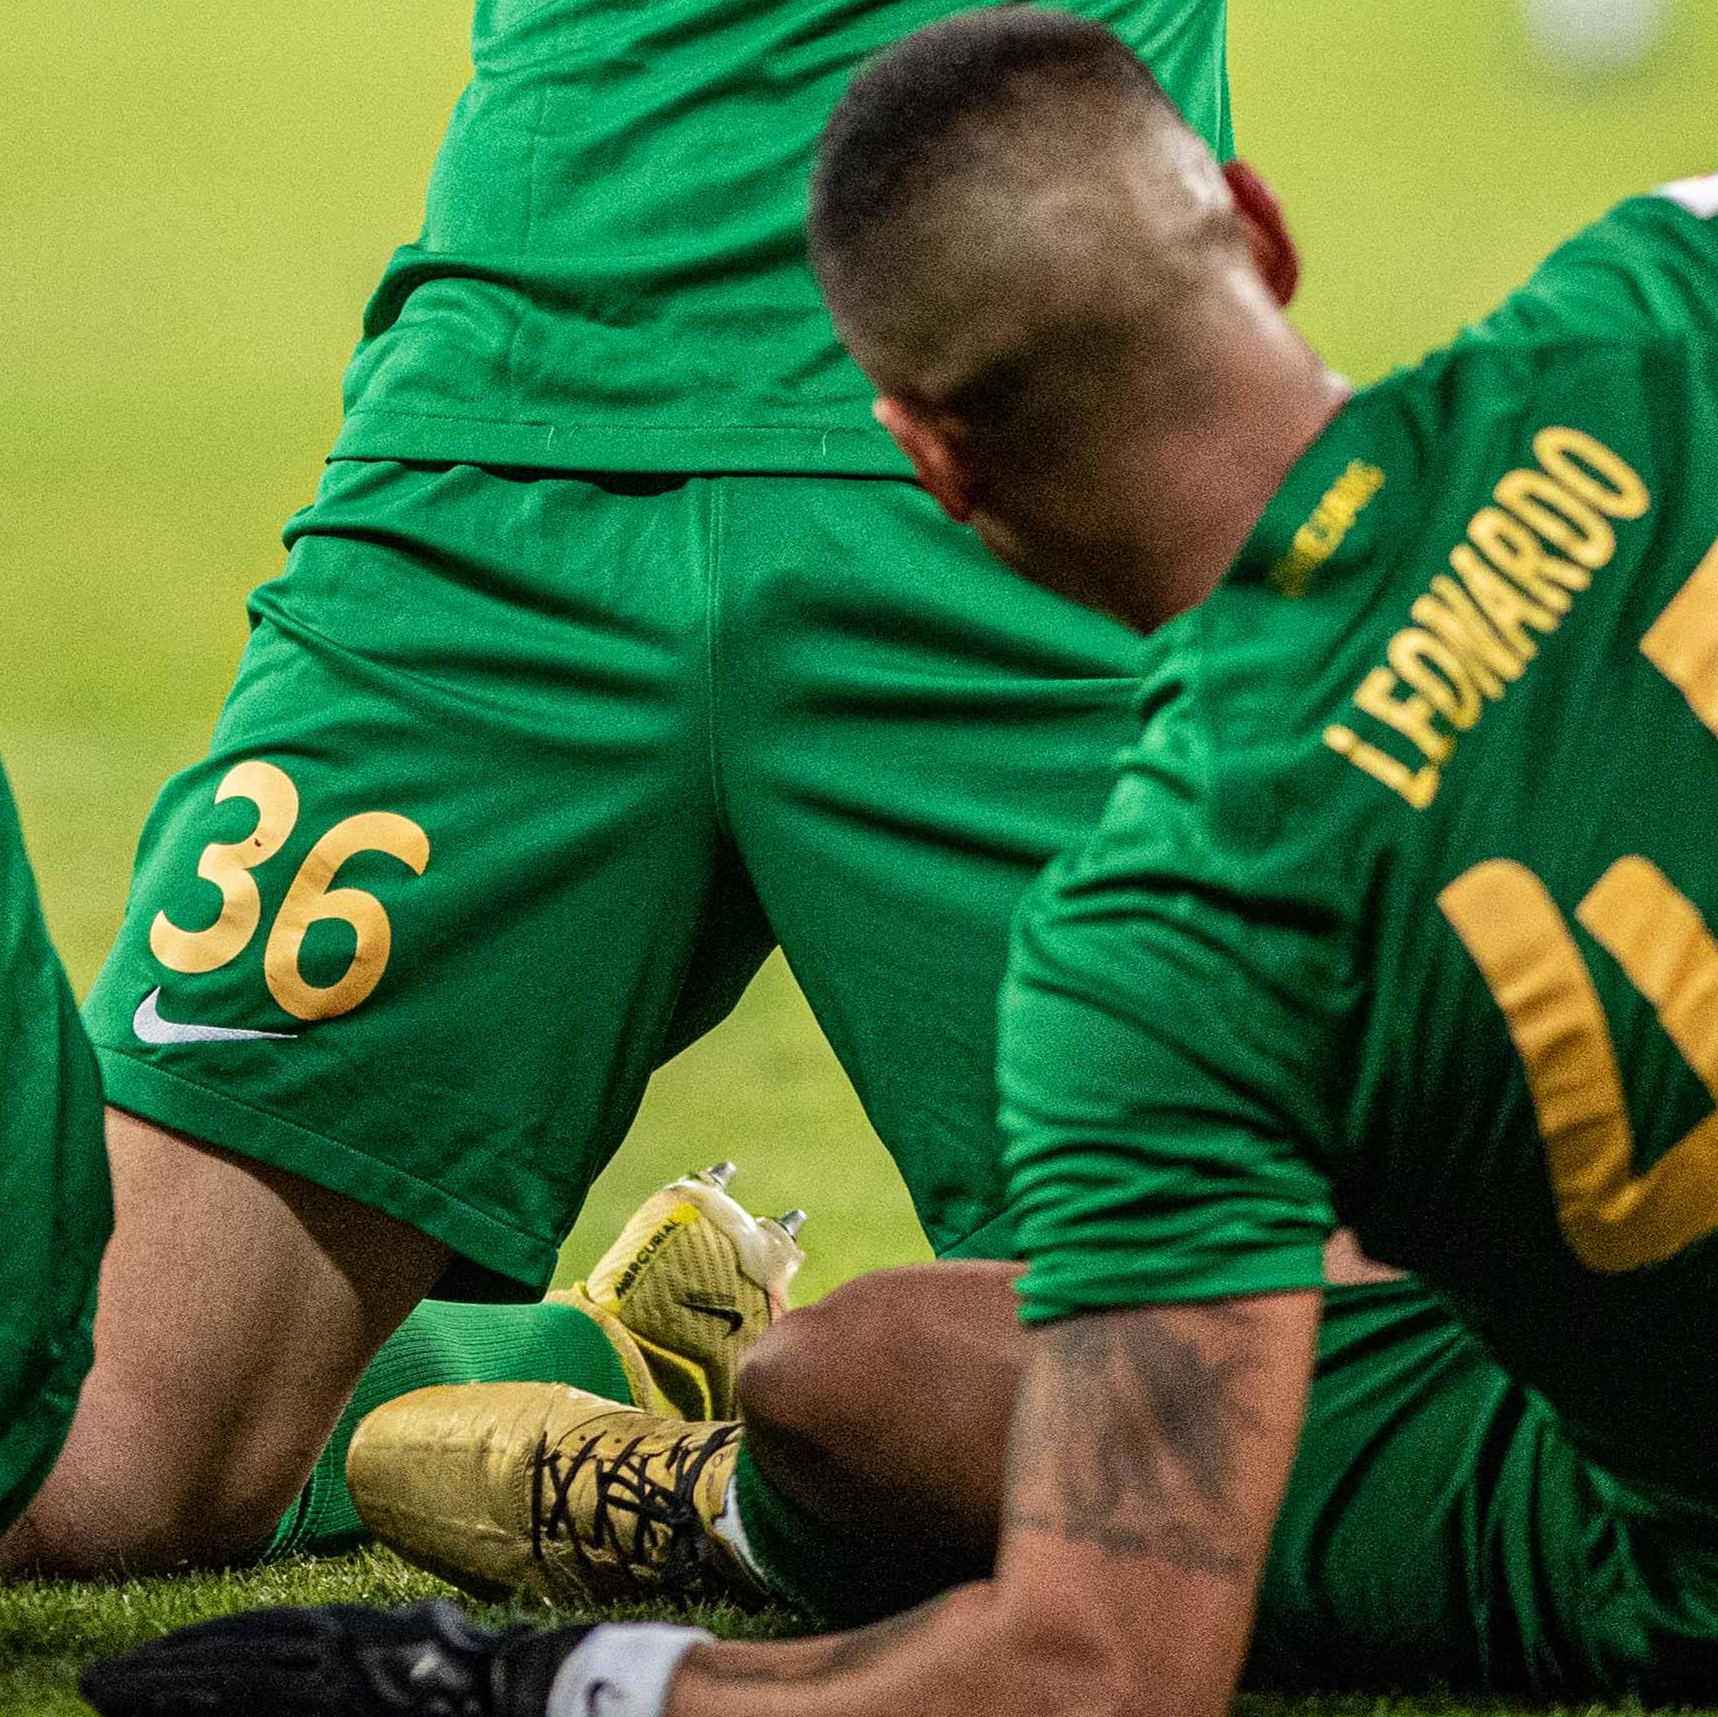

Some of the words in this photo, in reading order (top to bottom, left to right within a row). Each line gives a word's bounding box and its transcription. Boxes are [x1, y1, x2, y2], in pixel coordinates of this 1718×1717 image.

[1322, 426, 1651, 809] LEONARDO
[150, 760, 430, 1021] 36
[615, 1218, 680, 1300] MERCURIAL
